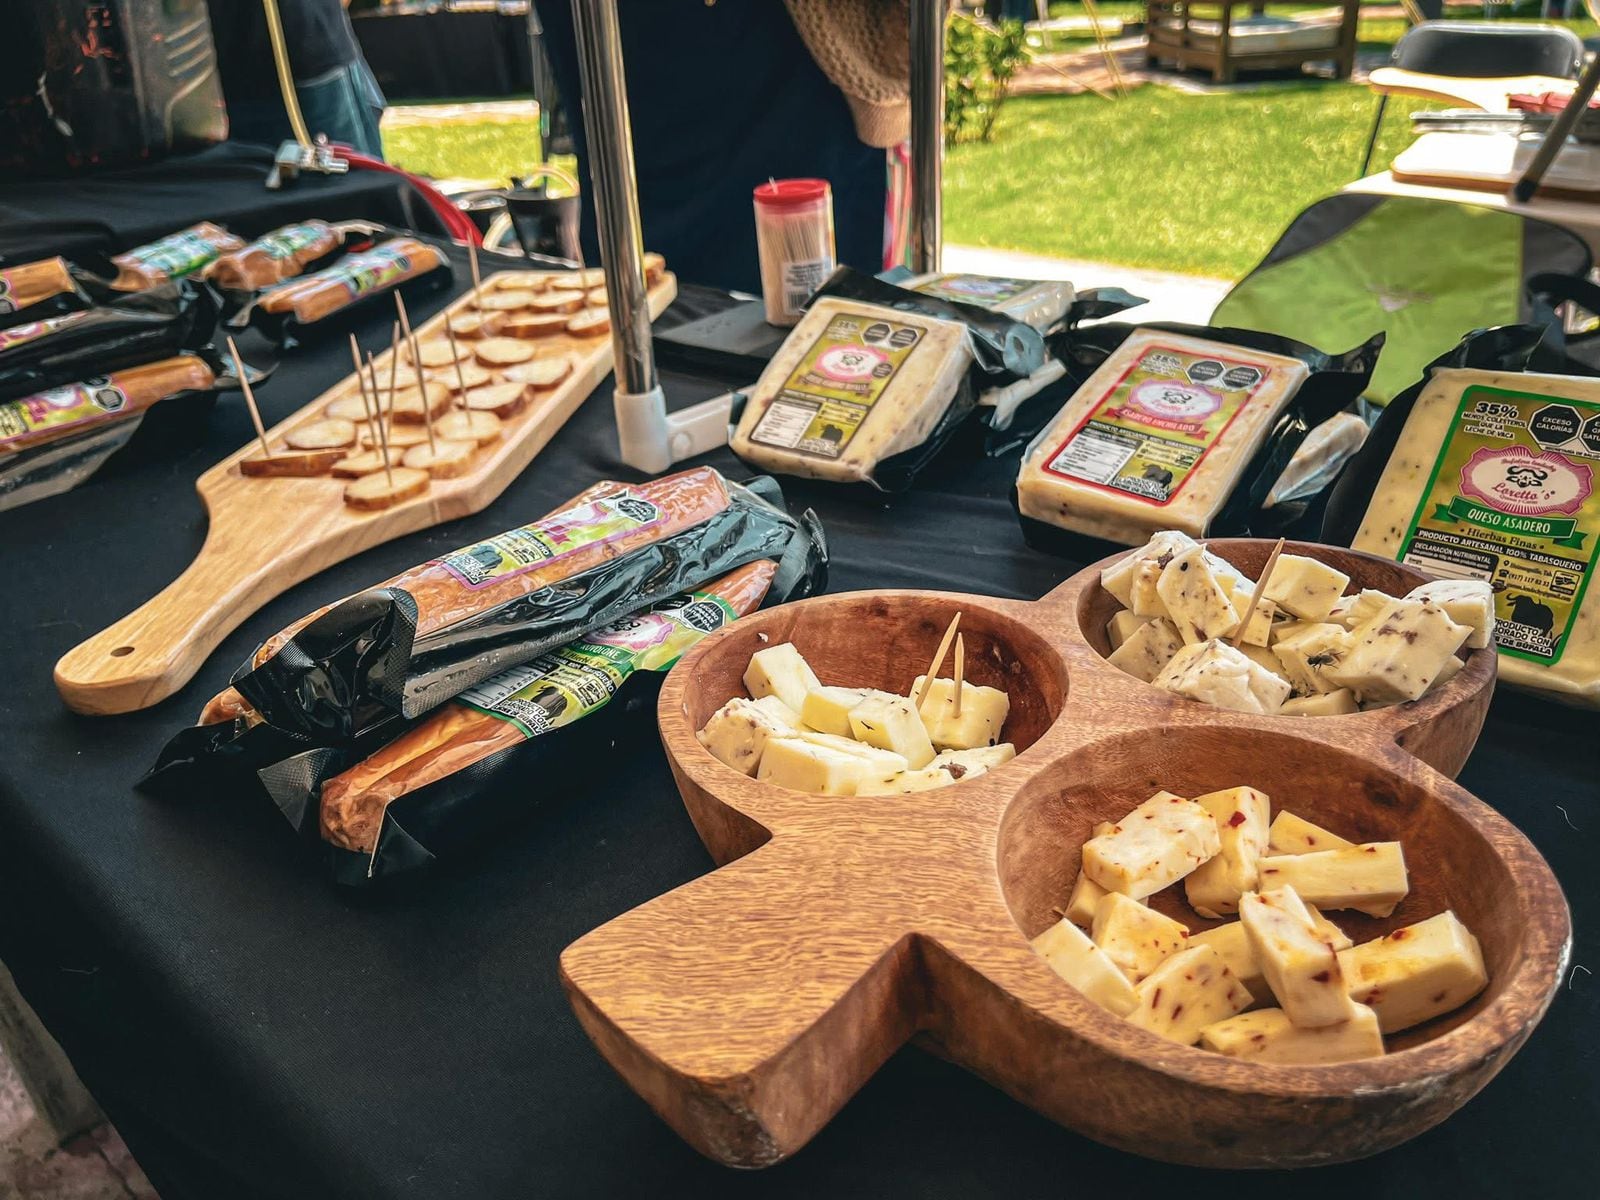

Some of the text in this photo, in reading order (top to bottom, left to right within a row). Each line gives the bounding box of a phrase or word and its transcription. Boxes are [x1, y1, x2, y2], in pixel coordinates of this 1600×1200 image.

[1475, 402, 1518, 419] 35%
[1486, 416, 1526, 428] COLESTEROL
[1542, 416, 1572, 426] EXCESO
[1467, 508, 1551, 534] QUESO ASADERO
[1467, 527, 1538, 550] Hierbas Finas
[1414, 542, 1453, 556] DECLARACIÓN
[1453, 551, 1491, 564] NUTRIMENTAL
[1418, 530, 1460, 544] PRODUCTO
[1460, 538, 1503, 554] ARTESANAL
[1506, 548, 1528, 559] 100%
[1529, 553, 1582, 571] TABASQUEÑO
[1502, 637, 1514, 645] DE
[1530, 636, 1550, 646] CON
